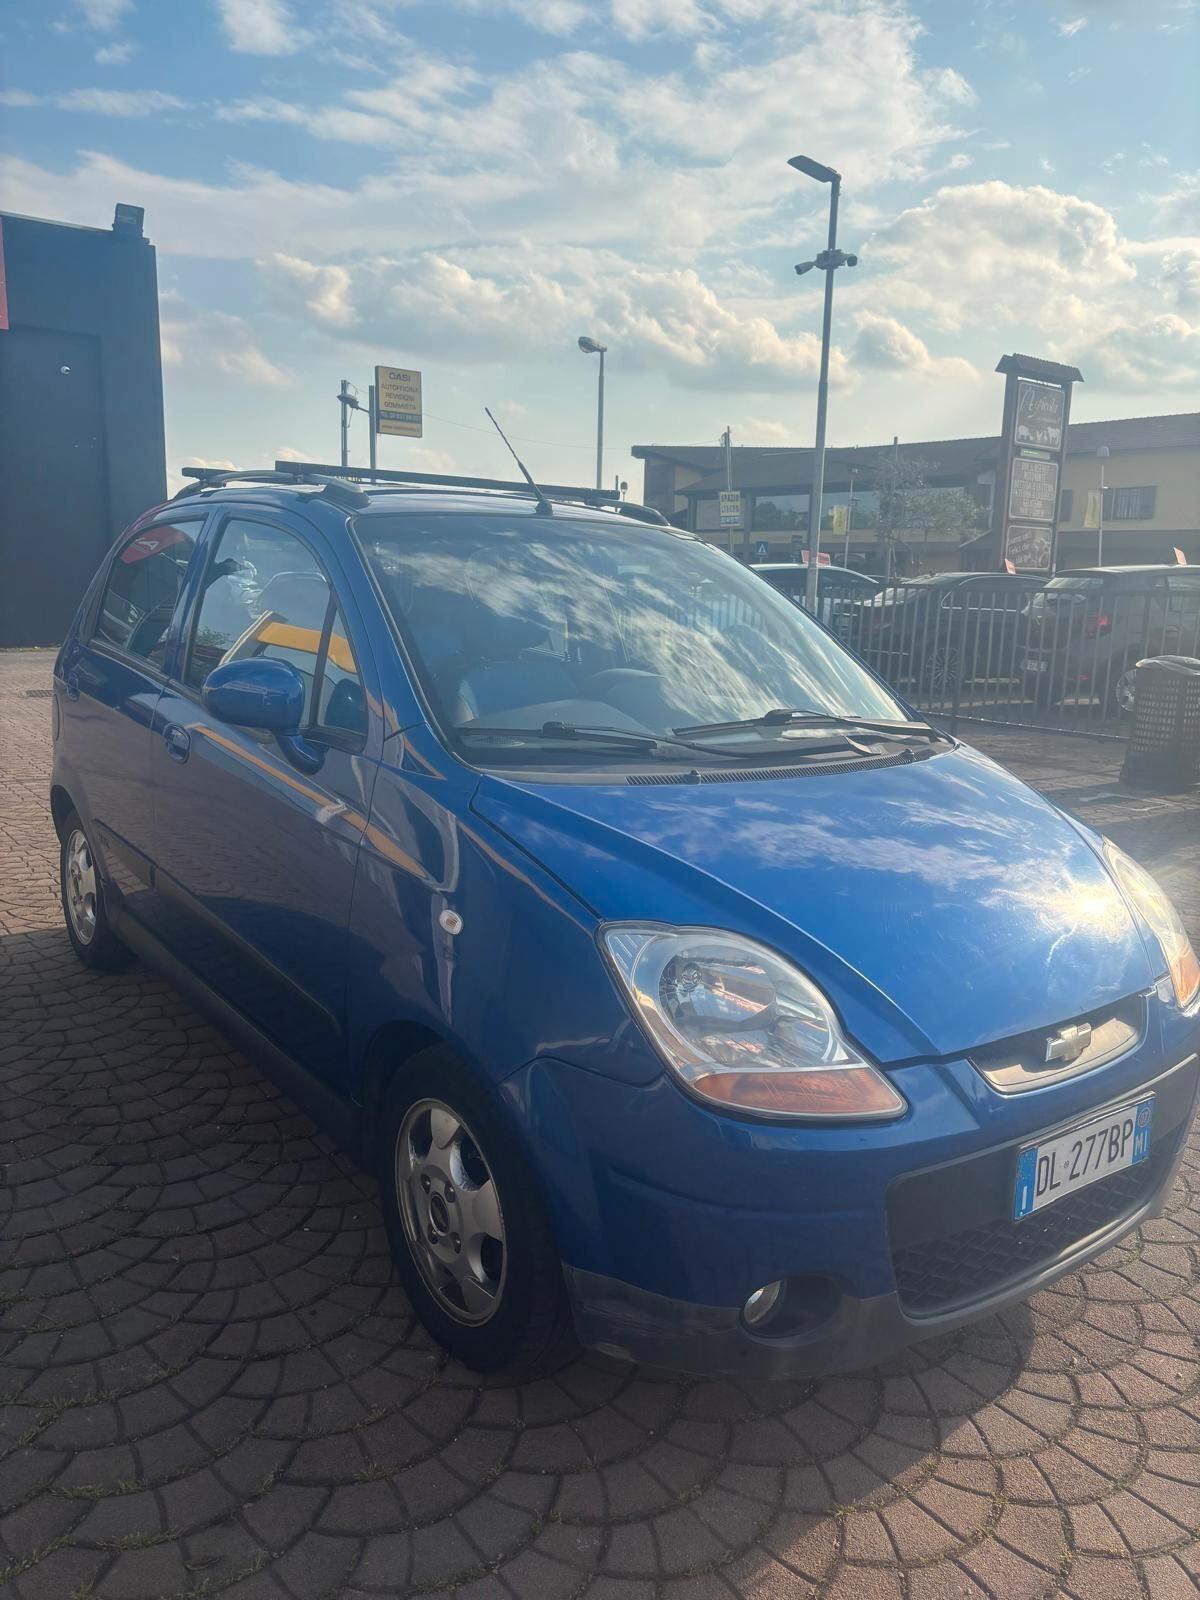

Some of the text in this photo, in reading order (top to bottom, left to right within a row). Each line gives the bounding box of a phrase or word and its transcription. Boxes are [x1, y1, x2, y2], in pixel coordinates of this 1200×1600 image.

[380, 383, 419, 393] AUTOFFICINA
[385, 392, 416, 402] REVISIONI
[384, 401, 417, 410] GOMMISTA
[1134, 1130, 1149, 1157] MI
[1036, 1118, 1134, 1197] DL 277BP
